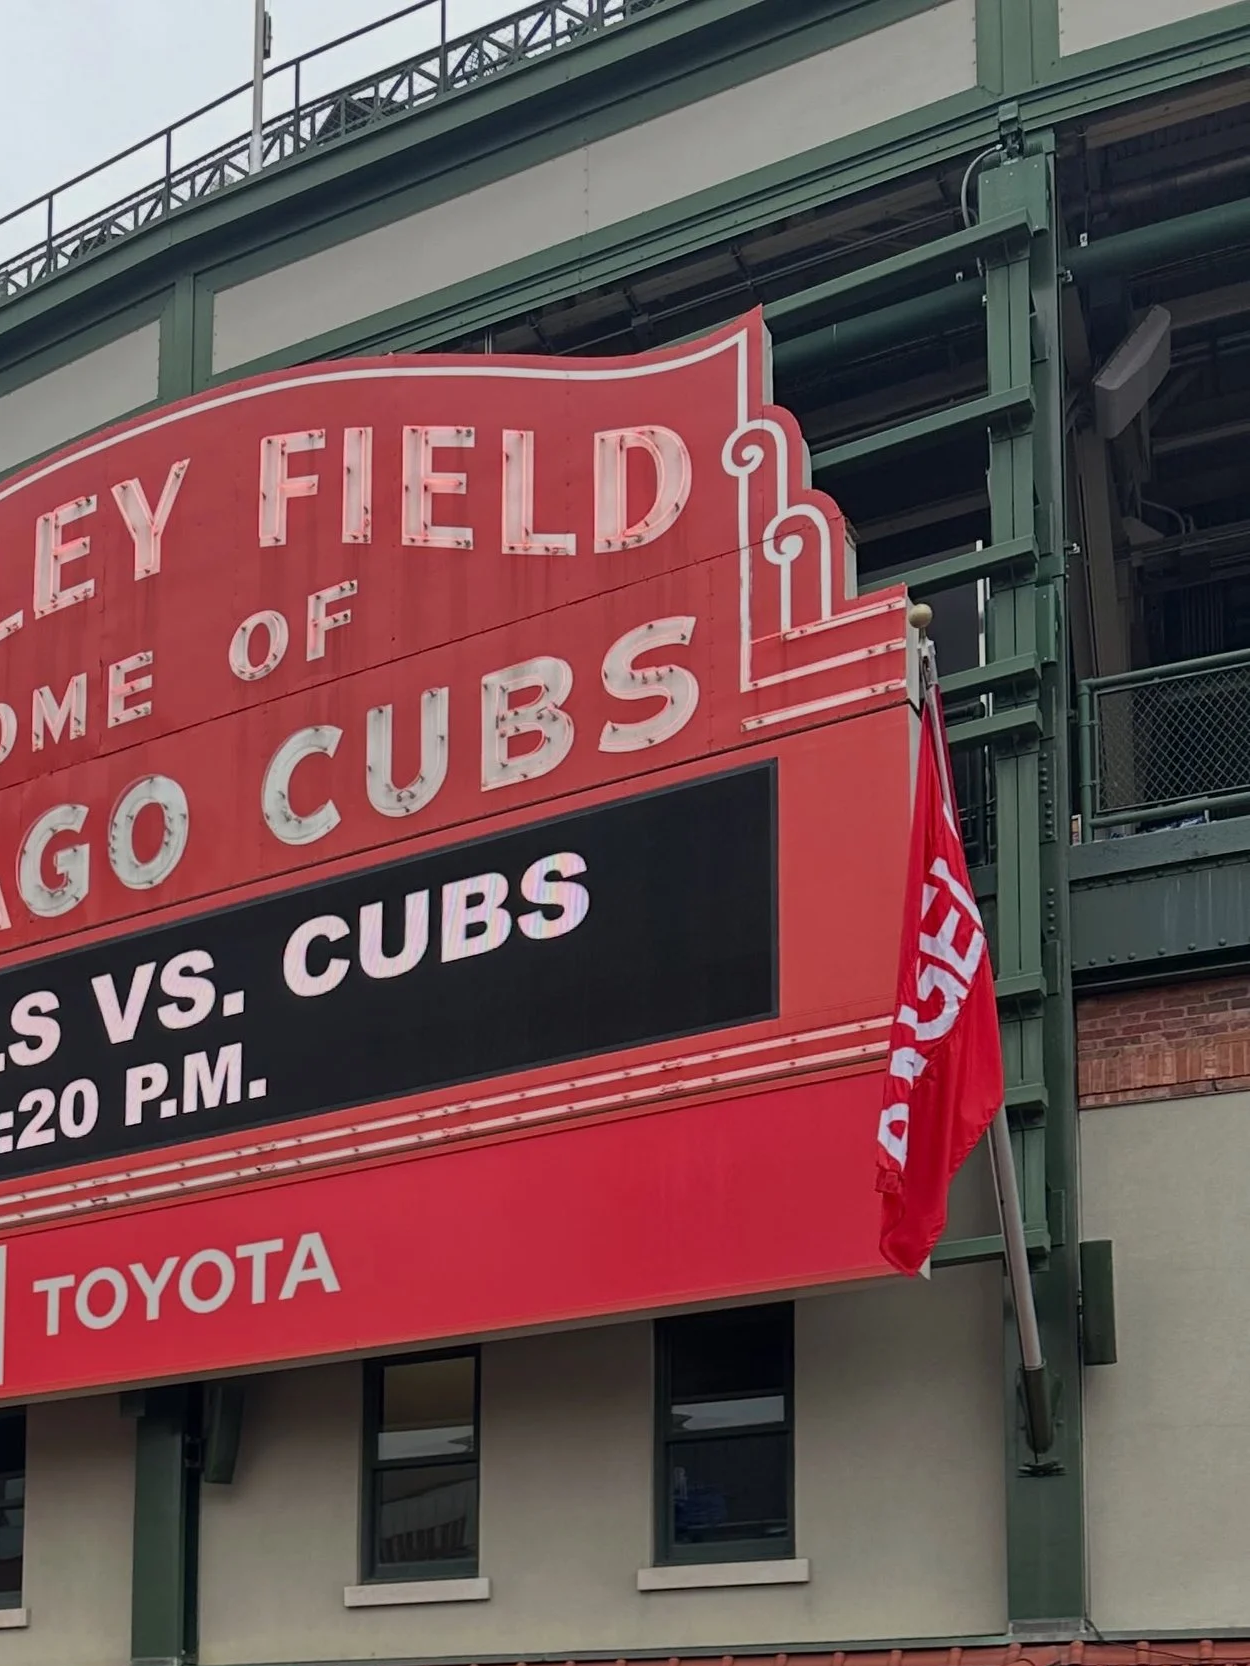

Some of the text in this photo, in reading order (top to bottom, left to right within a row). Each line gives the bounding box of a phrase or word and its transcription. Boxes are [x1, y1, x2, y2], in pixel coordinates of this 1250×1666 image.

[258, 425, 692, 556] FIELD
[229, 580, 358, 681] OF
[262, 616, 699, 846] CUBS
[91, 950, 245, 1046] VS.
[283, 852, 589, 997] CUBS
[125, 1043, 267, 1126] P.M.
[33, 1232, 341, 1337] TOYOTA
